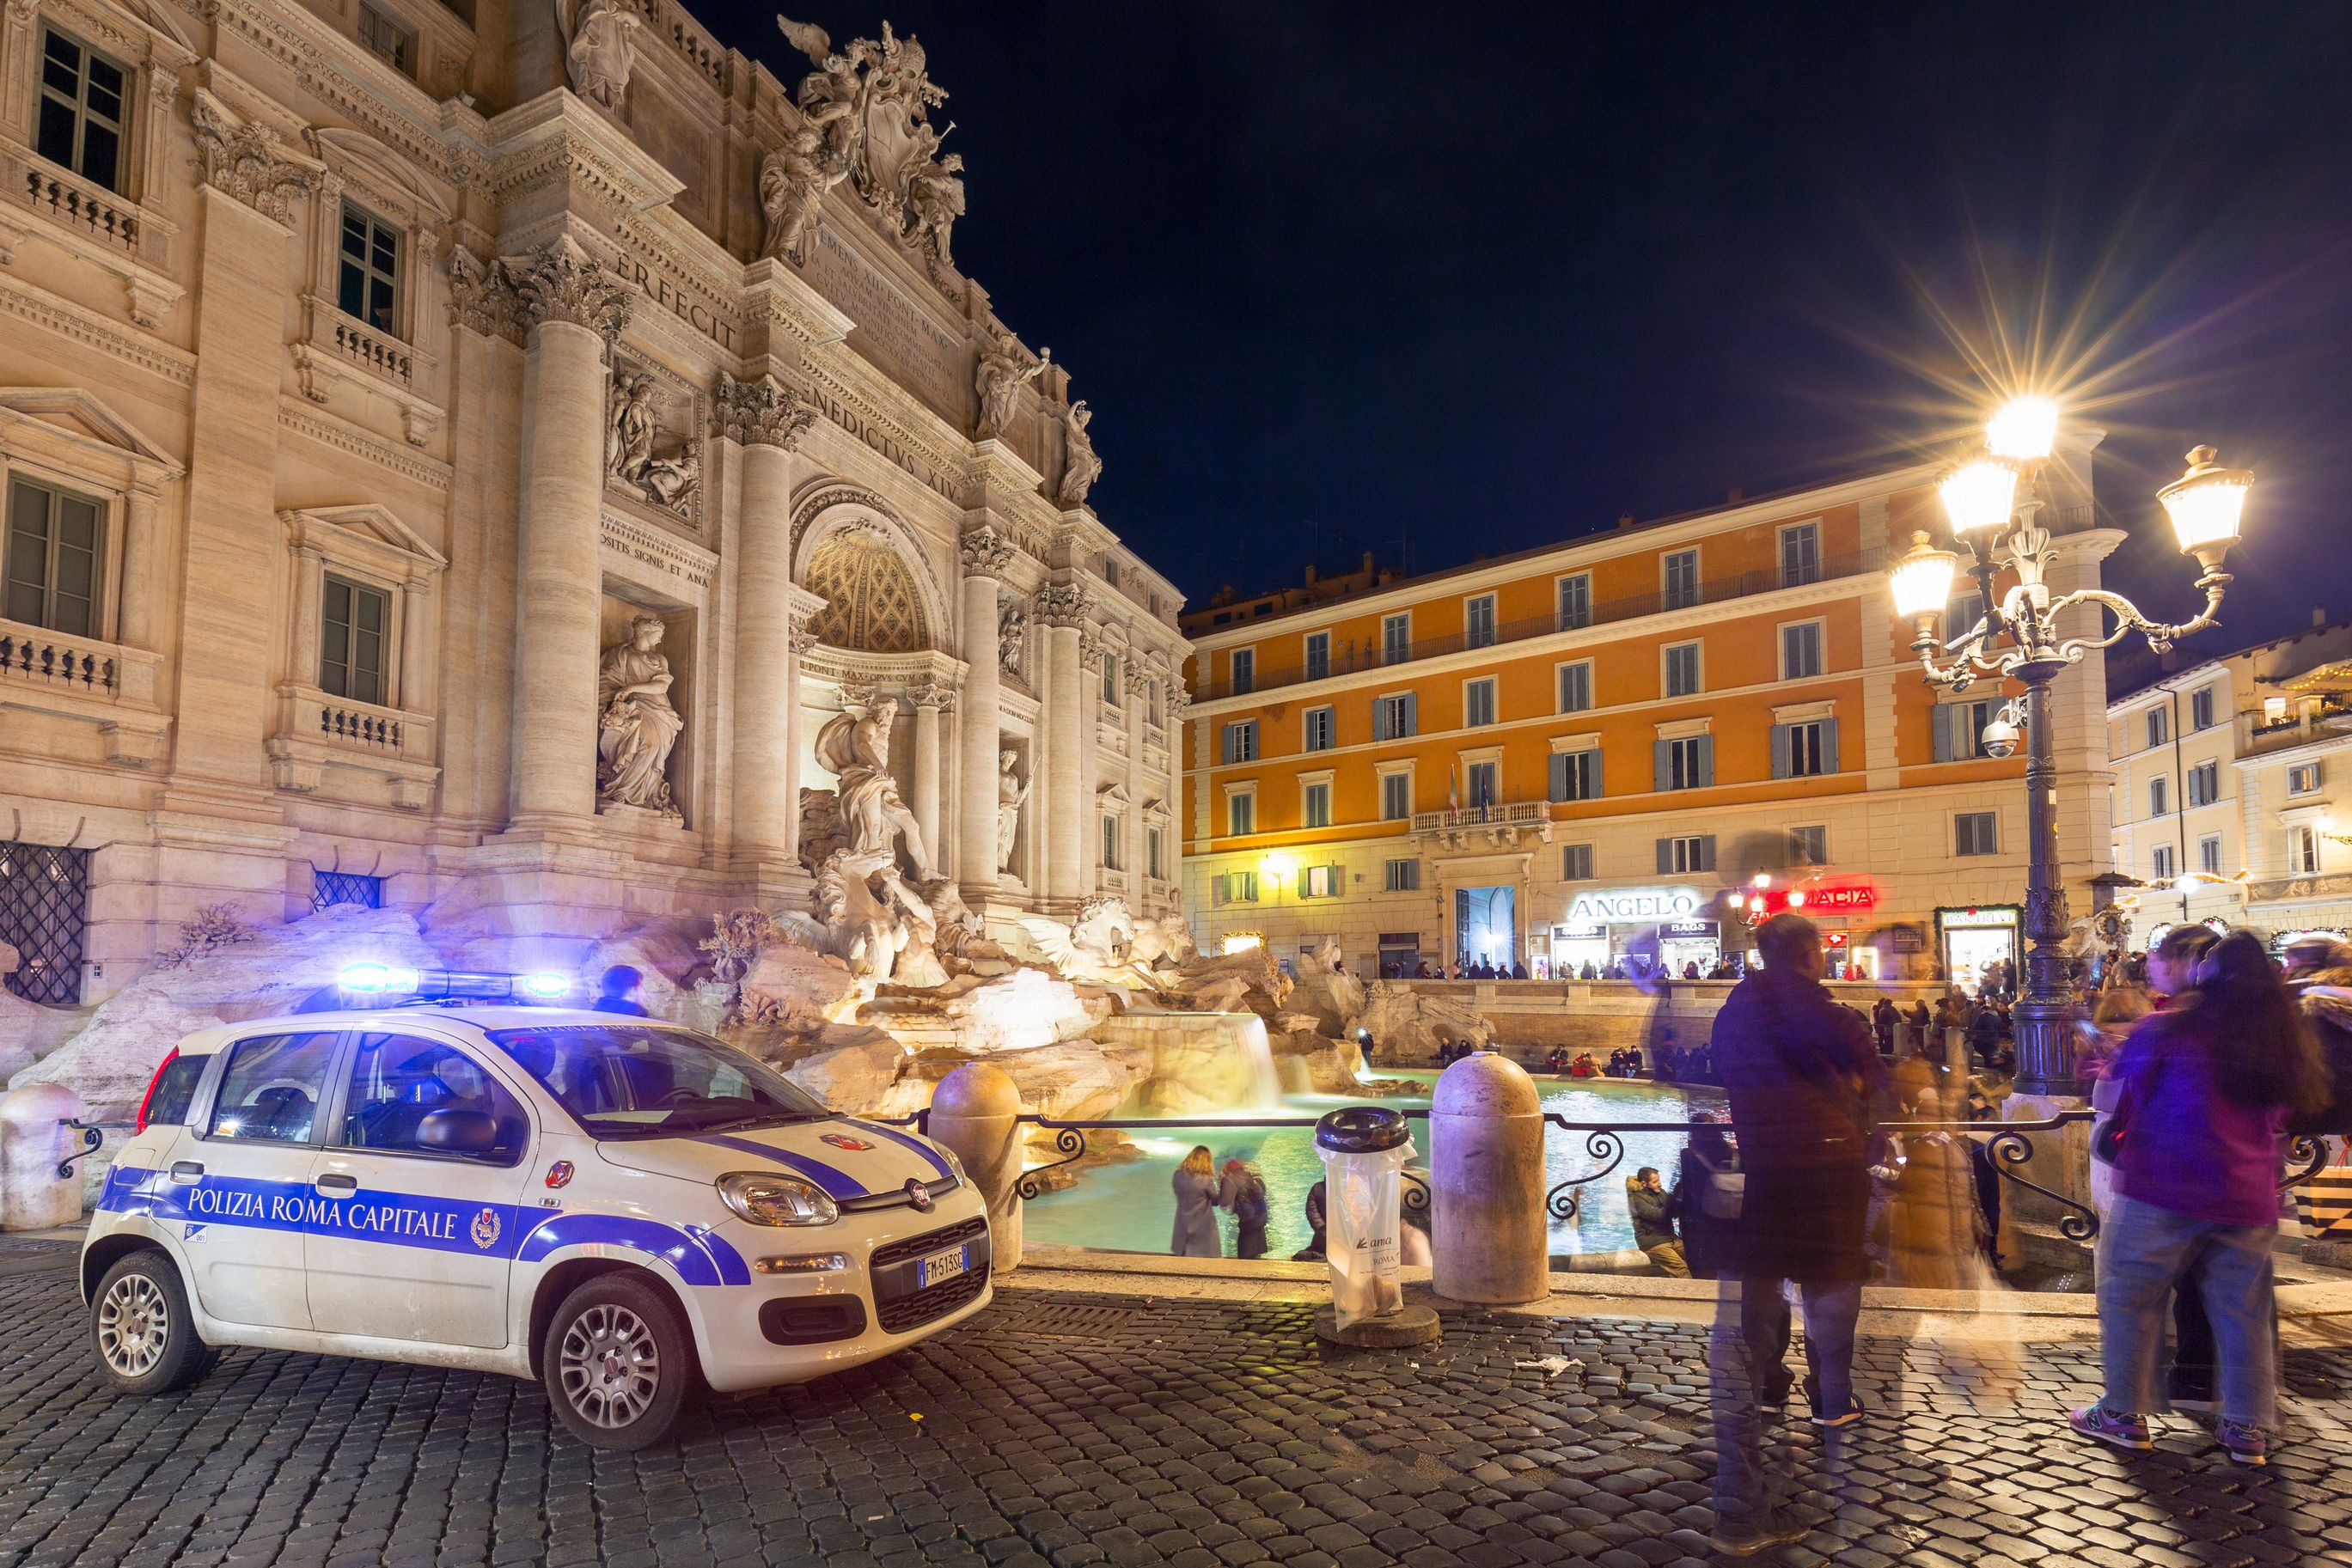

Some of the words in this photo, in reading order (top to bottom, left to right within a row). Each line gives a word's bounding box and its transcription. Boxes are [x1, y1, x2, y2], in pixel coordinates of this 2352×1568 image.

[821, 229, 858, 272] EMENS
[614, 253, 736, 350] ERFECIT
[801, 382, 914, 474] ENEDICTVS
[600, 534, 630, 554] OSITIS
[634, 549, 664, 569] SIGNIS
[670, 564, 681, 577] ET
[870, 674, 892, 682] OPVS
[895, 674, 916, 682] CVM
[1572, 895, 1694, 918] ANGELO
[1671, 922, 1706, 932] BAGS
[187, 1188, 265, 1218] POLIZIA
[271, 1196, 342, 1227] ROMA
[348, 1205, 458, 1240] CAPITALE
[1370, 1237, 1392, 1248] ama
[1373, 1255, 1396, 1265] ROMA
